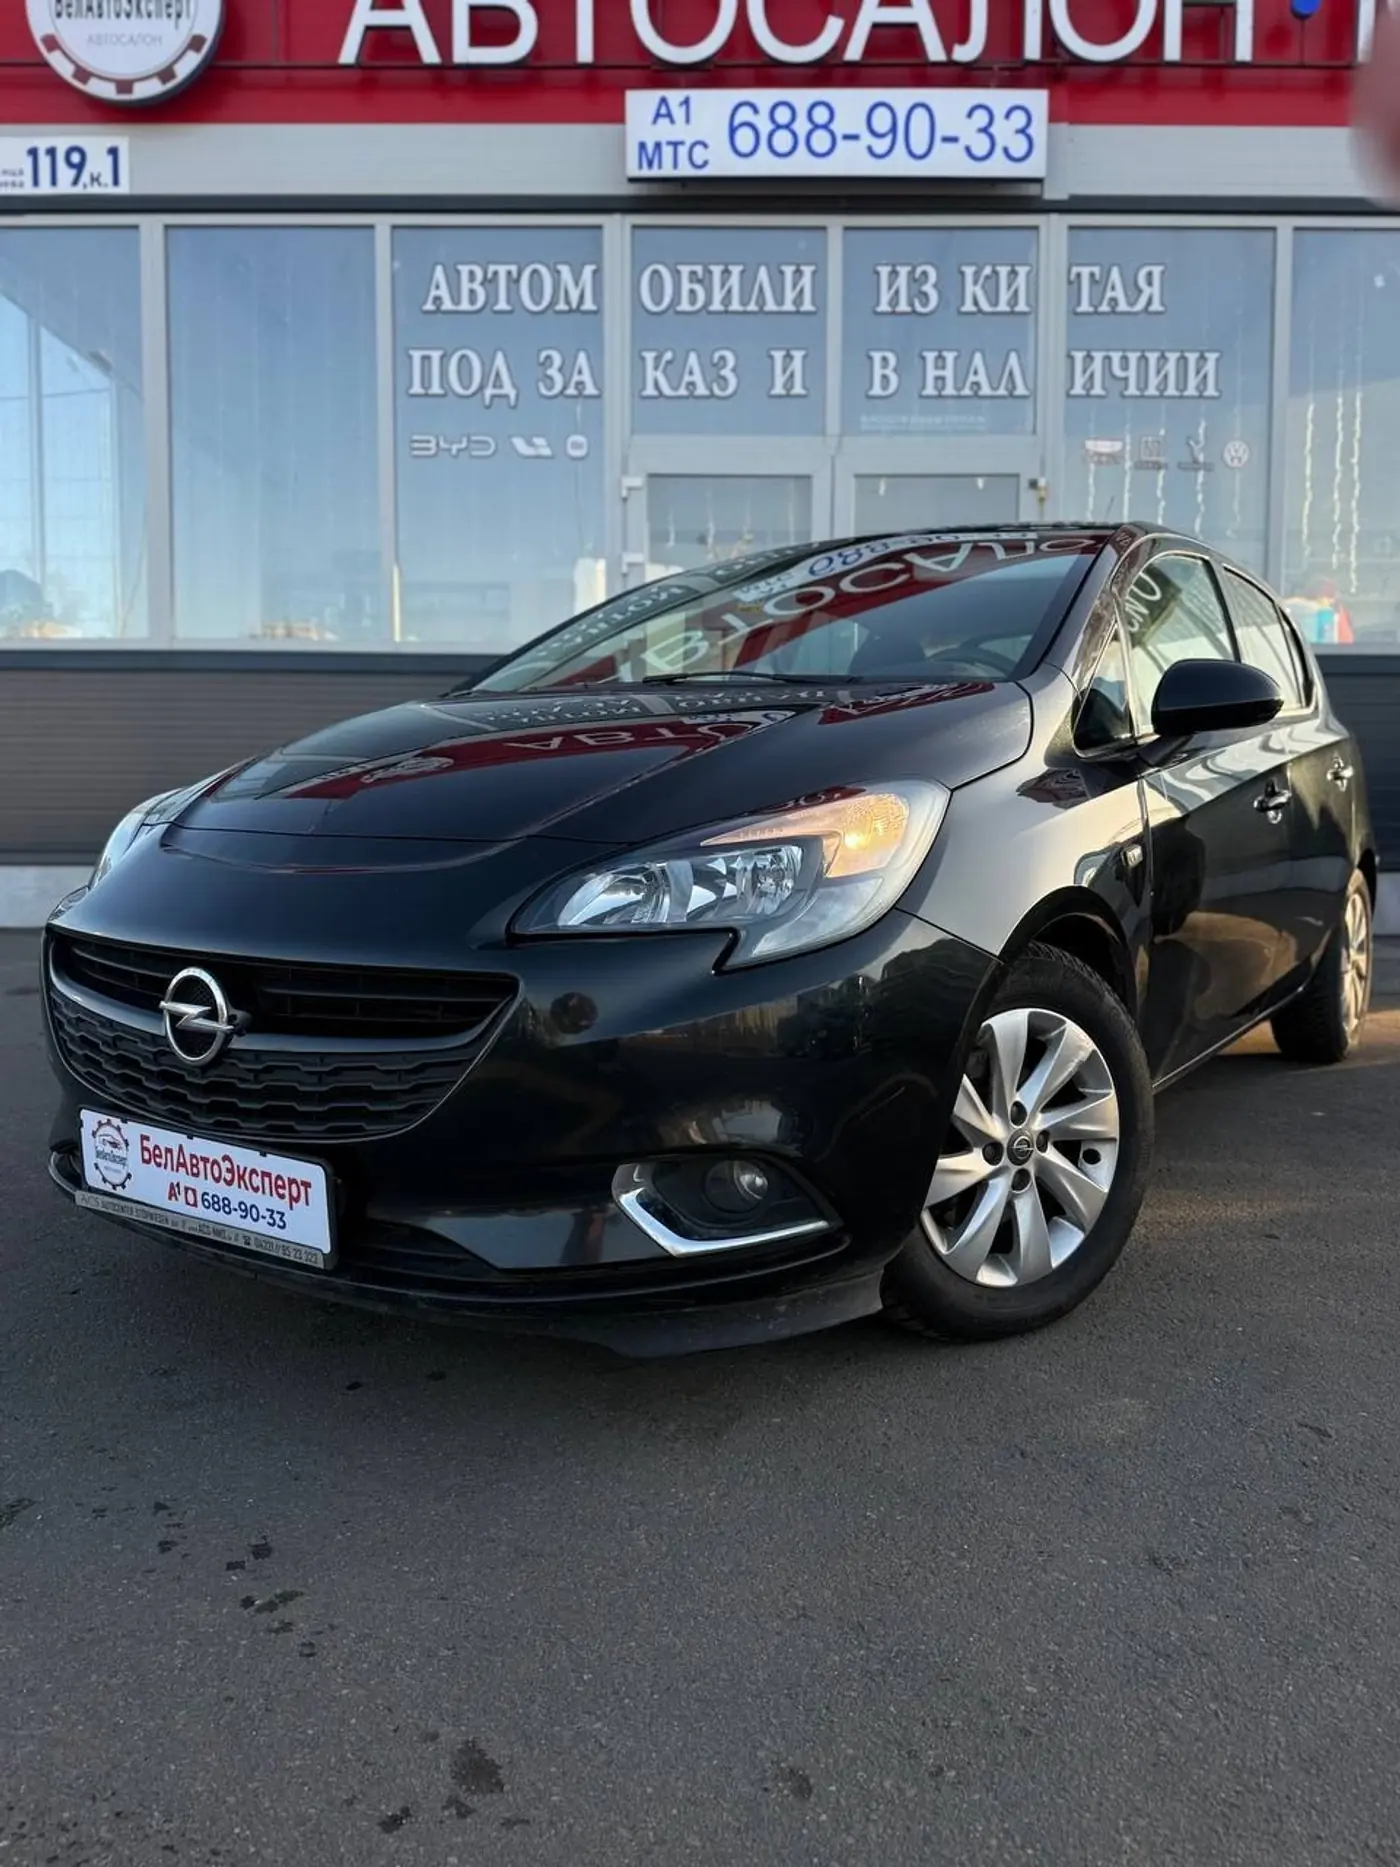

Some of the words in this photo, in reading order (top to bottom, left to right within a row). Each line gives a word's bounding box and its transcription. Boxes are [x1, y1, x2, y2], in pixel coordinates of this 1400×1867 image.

[87, 33, 163, 46] АВТОСАЛОН
[651, 96, 692, 126] A1
[728, 100, 1035, 163] 688-90-33
[637, 141, 710, 170] МТС
[422, 262, 598, 314] АВТОМ
[639, 262, 818, 314] ОБИЛИ
[874, 263, 939, 314] ИЗ
[959, 263, 1032, 314] КИ
[1070, 264, 1166, 314] ТАЯ
[408, 348, 518, 408] ПОД
[537, 349, 600, 398] ЗА
[640, 349, 739, 398] КАЗ
[769, 349, 808, 397] И
[867, 350, 899, 397] В
[921, 350, 1031, 397] НАЛ
[1068, 350, 1222, 398] ИЧИИ
[410, 434, 496, 457] BYD
[139, 1133, 313, 1211] БелАвтоЭксперт
[201, 1191, 287, 1231] 688-90-33
